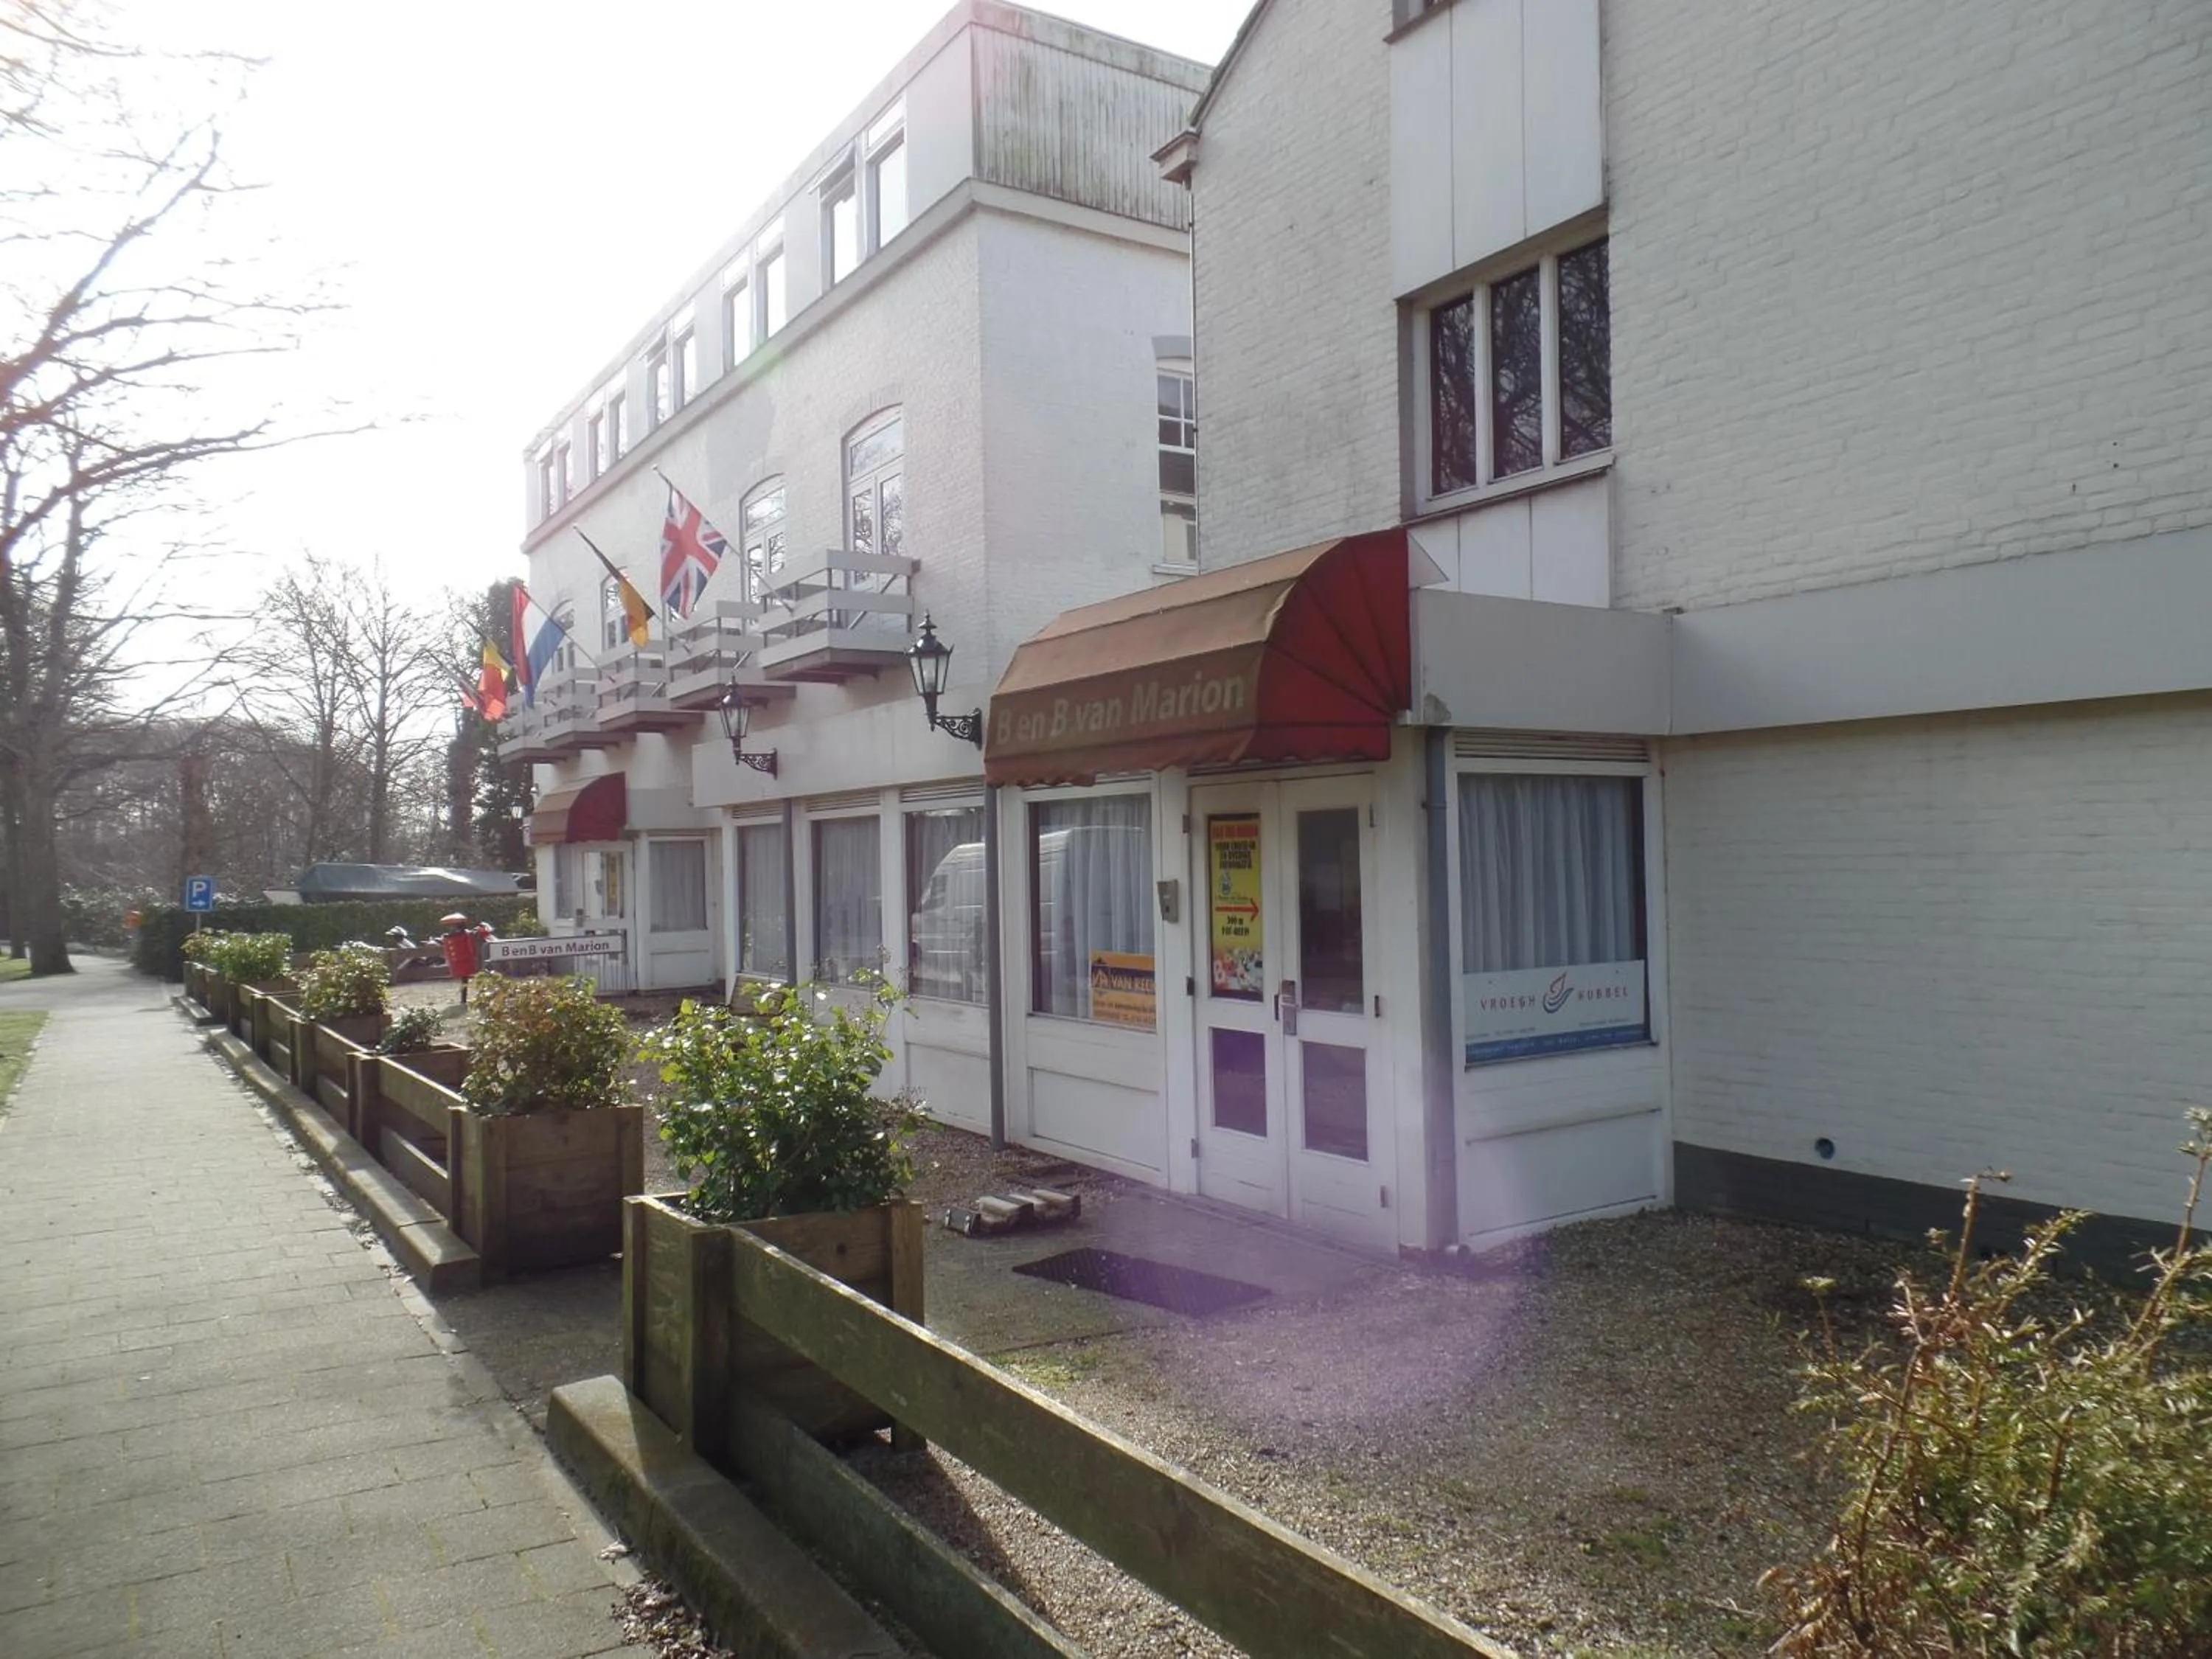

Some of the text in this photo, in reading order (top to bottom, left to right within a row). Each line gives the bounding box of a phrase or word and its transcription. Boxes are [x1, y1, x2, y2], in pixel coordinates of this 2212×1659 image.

[1074, 697, 1121, 732] van
[1130, 671, 1245, 726] Marion
[192, 881, 206, 897] P
[540, 944, 562, 954] van
[566, 940, 610, 953] Marion
[1112, 973, 1132, 990] VAN
